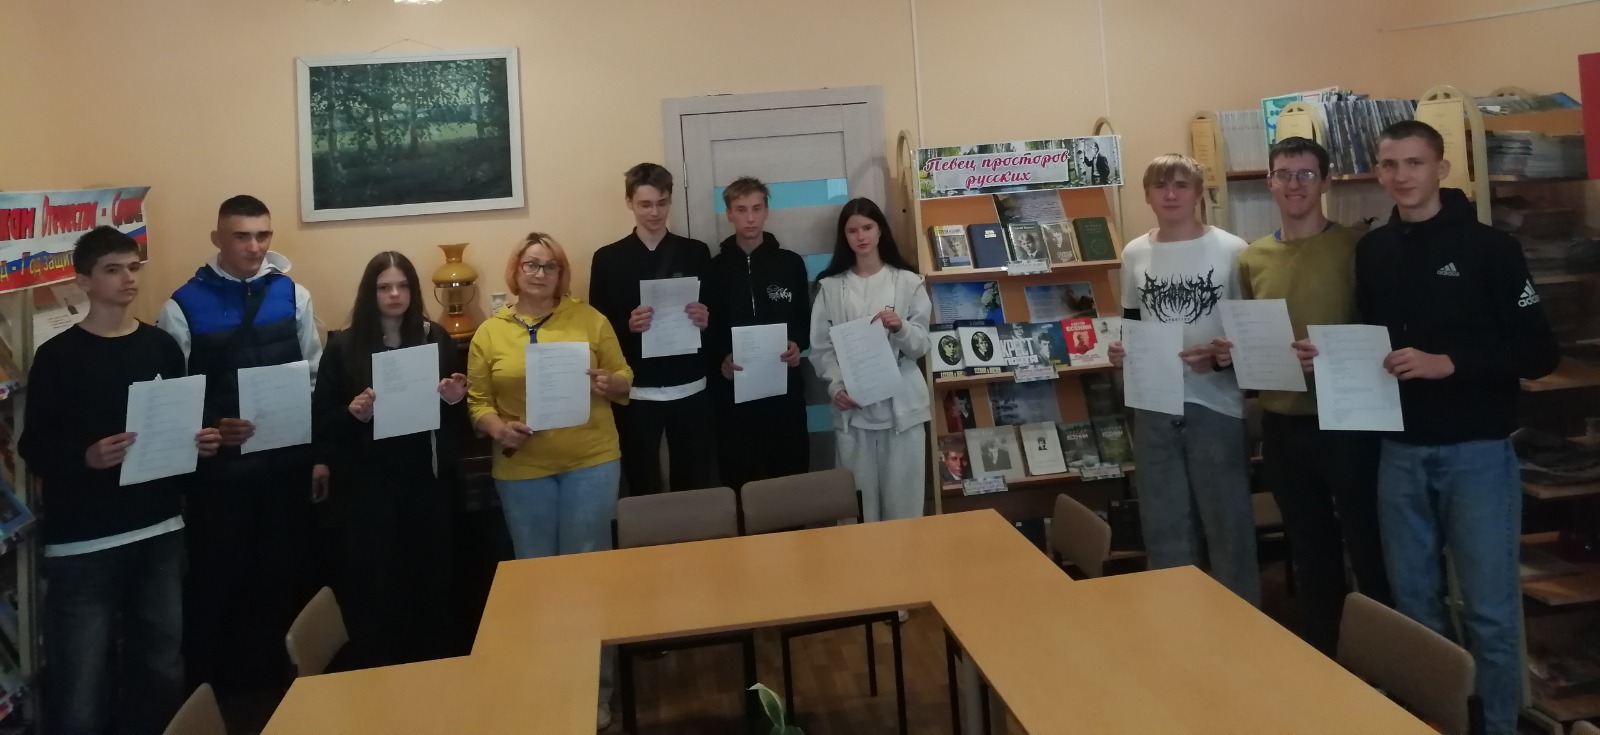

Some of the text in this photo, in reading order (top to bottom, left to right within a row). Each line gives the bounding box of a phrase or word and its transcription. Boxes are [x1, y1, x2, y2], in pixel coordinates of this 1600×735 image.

[923, 150, 1069, 172] Певец просторов
[965, 171, 1031, 189] русских
